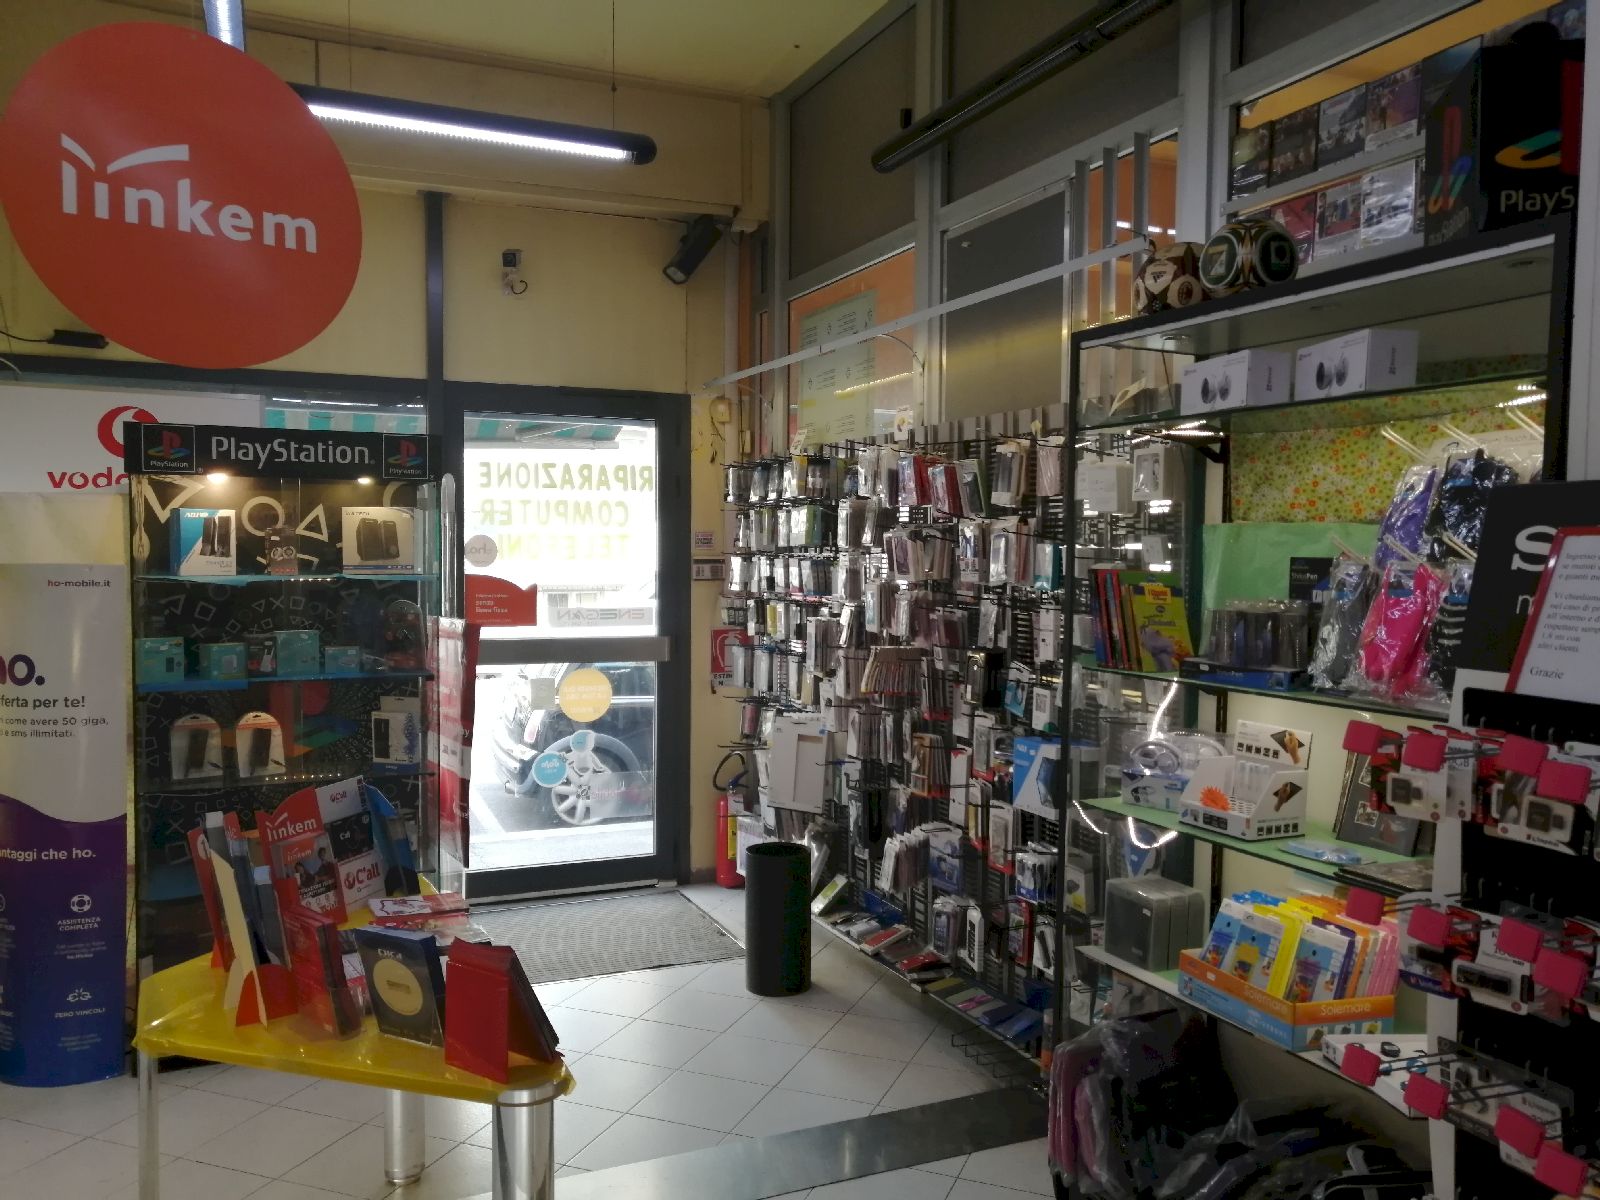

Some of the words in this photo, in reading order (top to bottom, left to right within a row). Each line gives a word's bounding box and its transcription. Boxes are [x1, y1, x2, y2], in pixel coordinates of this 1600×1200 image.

[61, 146, 318, 253] linkem
[211, 435, 370, 469] PlayStation
[47, 578, 112, 588] ho-mobile.it
[1529, 665, 1565, 680] Grazie
[33, 697, 59, 710] per
[63, 695, 86, 708] te!
[30, 718, 59, 726] avere
[62, 716, 77, 726] 50
[80, 716, 110, 727] giga,
[265, 818, 318, 842] linkem
[41, 849, 68, 861] che
[72, 847, 97, 859] ho.
[59, 922, 100, 932] COMPLETA
[1319, 1003, 1372, 1017] Solemare
